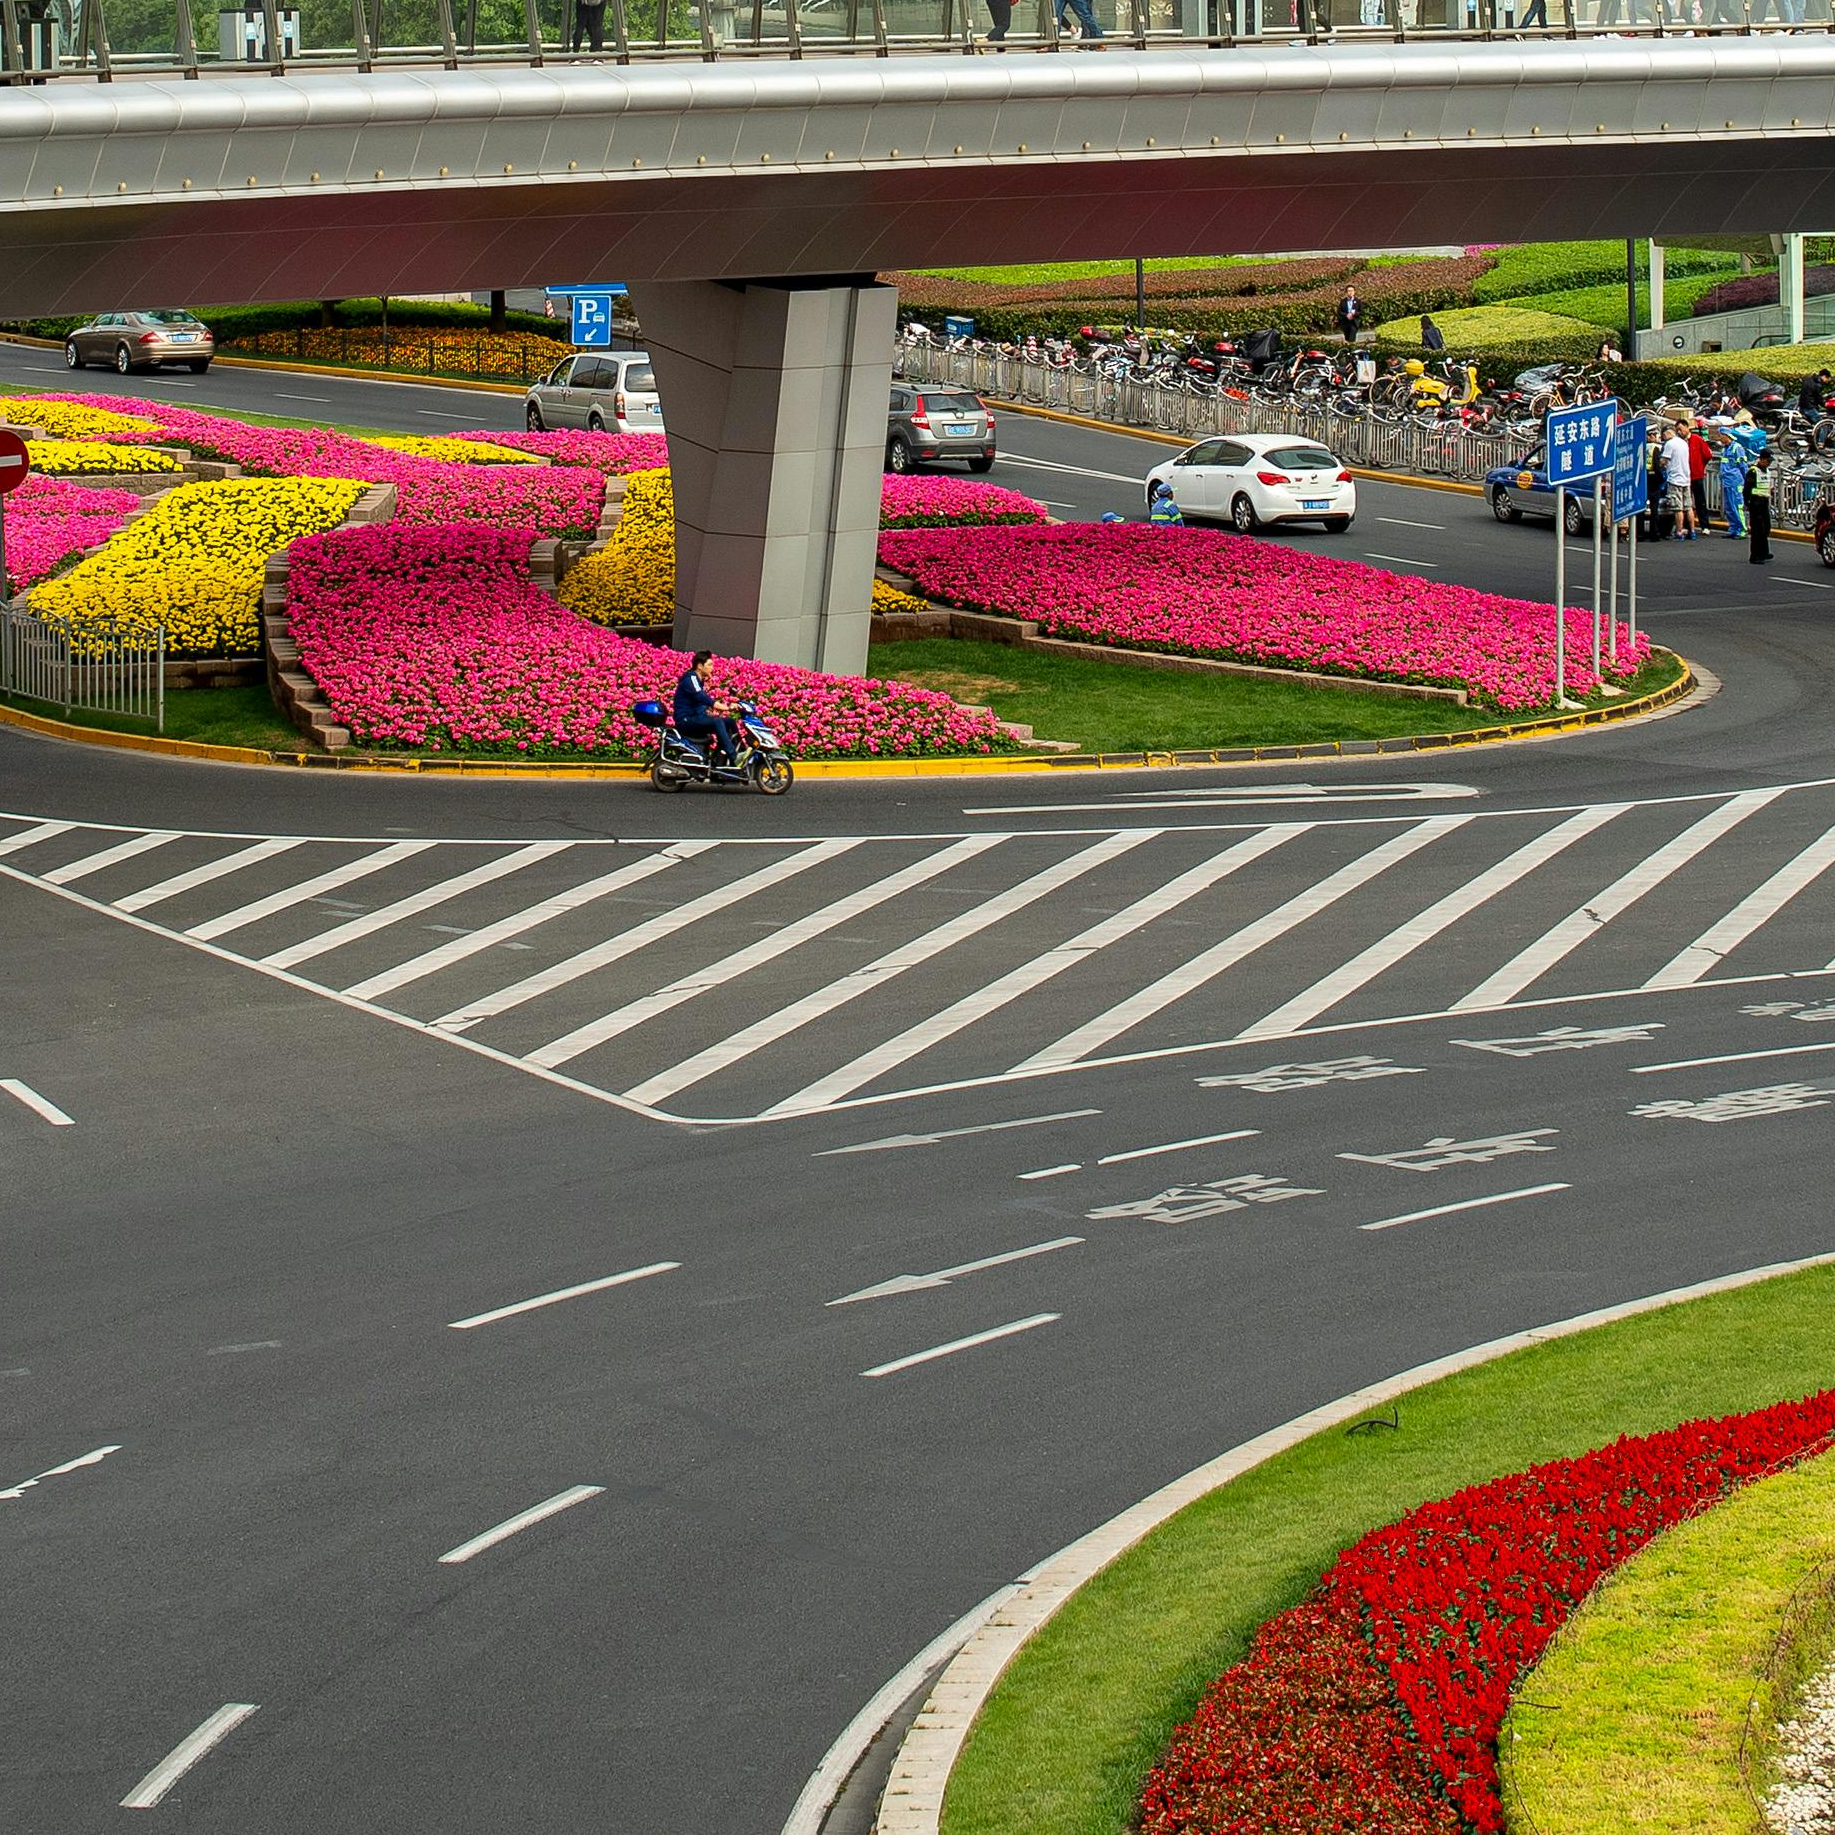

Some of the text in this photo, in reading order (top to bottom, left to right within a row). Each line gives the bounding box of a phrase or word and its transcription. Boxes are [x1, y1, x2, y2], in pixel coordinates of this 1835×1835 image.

[578, 299, 597, 324] P
[1553, 415, 1601, 447] 延安东路
[1560, 443, 1595, 473] 隧道
